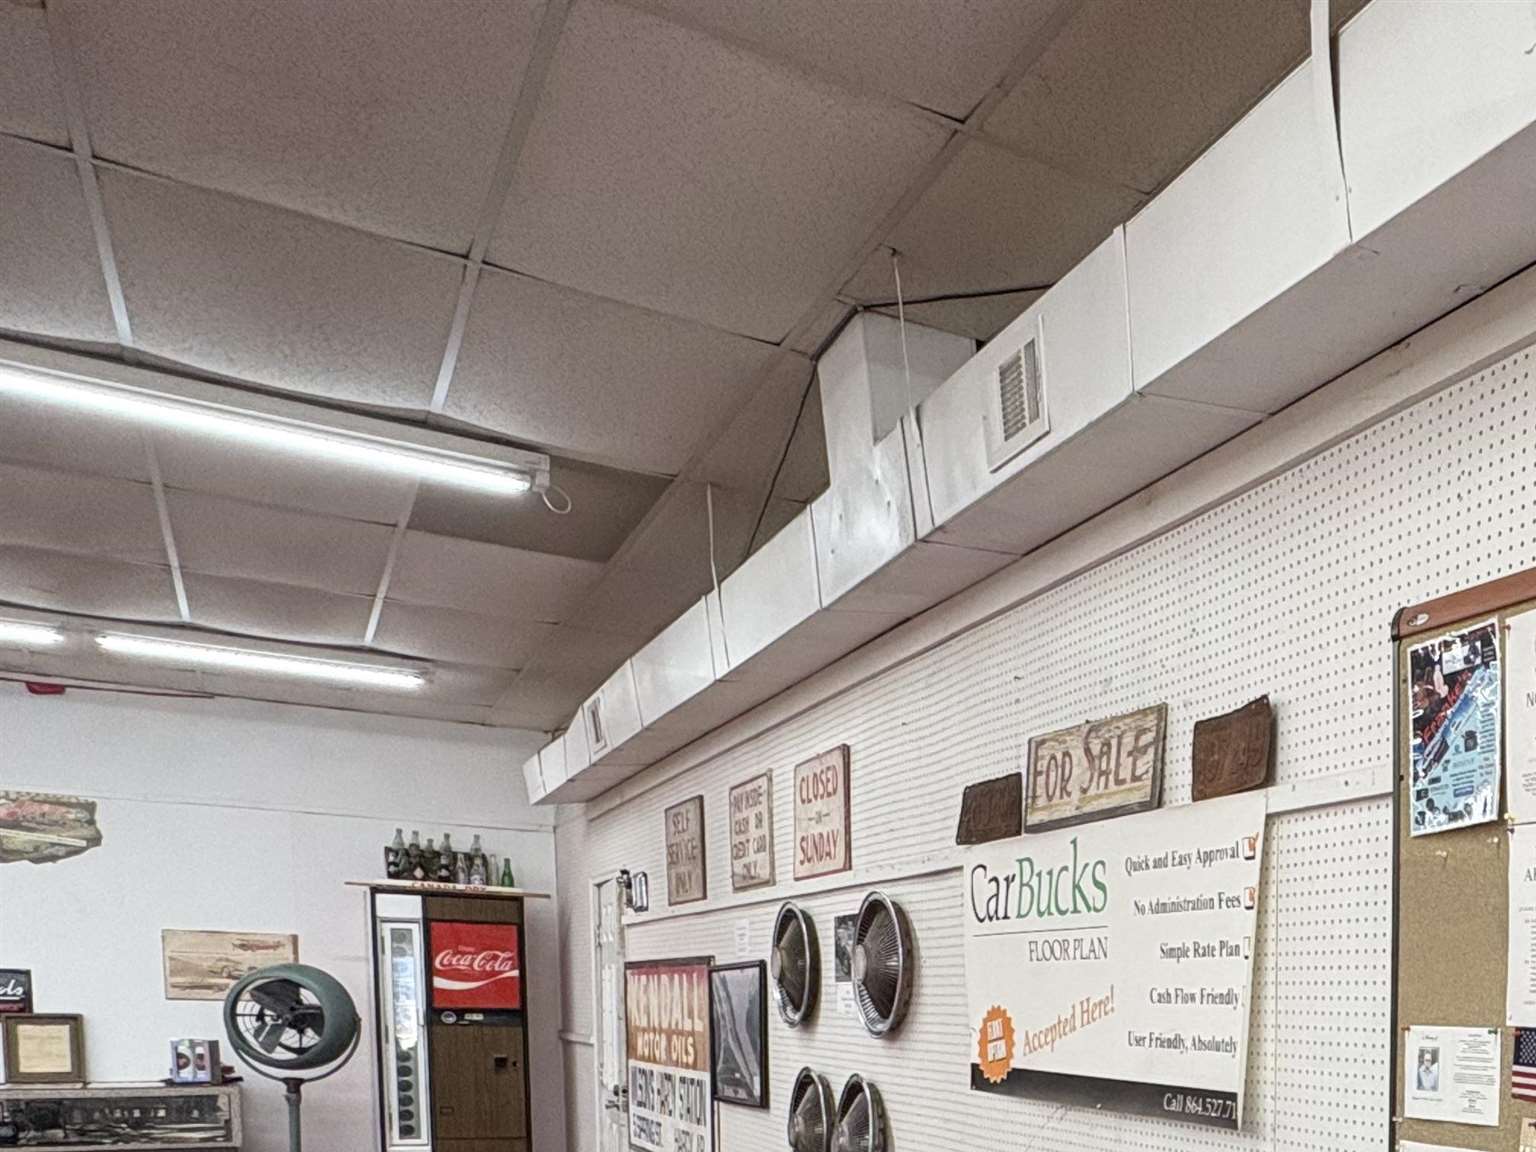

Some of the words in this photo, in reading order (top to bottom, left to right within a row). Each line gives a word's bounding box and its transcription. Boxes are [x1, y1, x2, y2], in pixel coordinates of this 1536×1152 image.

[1031, 739, 1073, 806] FOR
[1079, 722, 1156, 794] SALE
[799, 765, 838, 805] CLOSED
[799, 832, 839, 866] SUNDAY
[1124, 855, 1149, 877] Quick
[1153, 850, 1168, 870] and
[1171, 847, 1193, 870] Easy
[1196, 842, 1240, 864] Approval
[971, 836, 1108, 924] CarBucks
[434, 948, 517, 973] Coca-Cola
[1028, 939, 1070, 963] FLOOR
[1074, 937, 1108, 960] PLAN
[1159, 941, 1190, 960] Simple
[1194, 940, 1216, 958] Rate
[1218, 941, 1241, 958] Plan
[628, 971, 703, 1031] KENDALL
[1022, 1003, 1077, 1057] Accepted
[1080, 984, 1115, 1029] Here!
[637, 1037, 666, 1063] MOTOR
[670, 1037, 694, 1064] OILS
